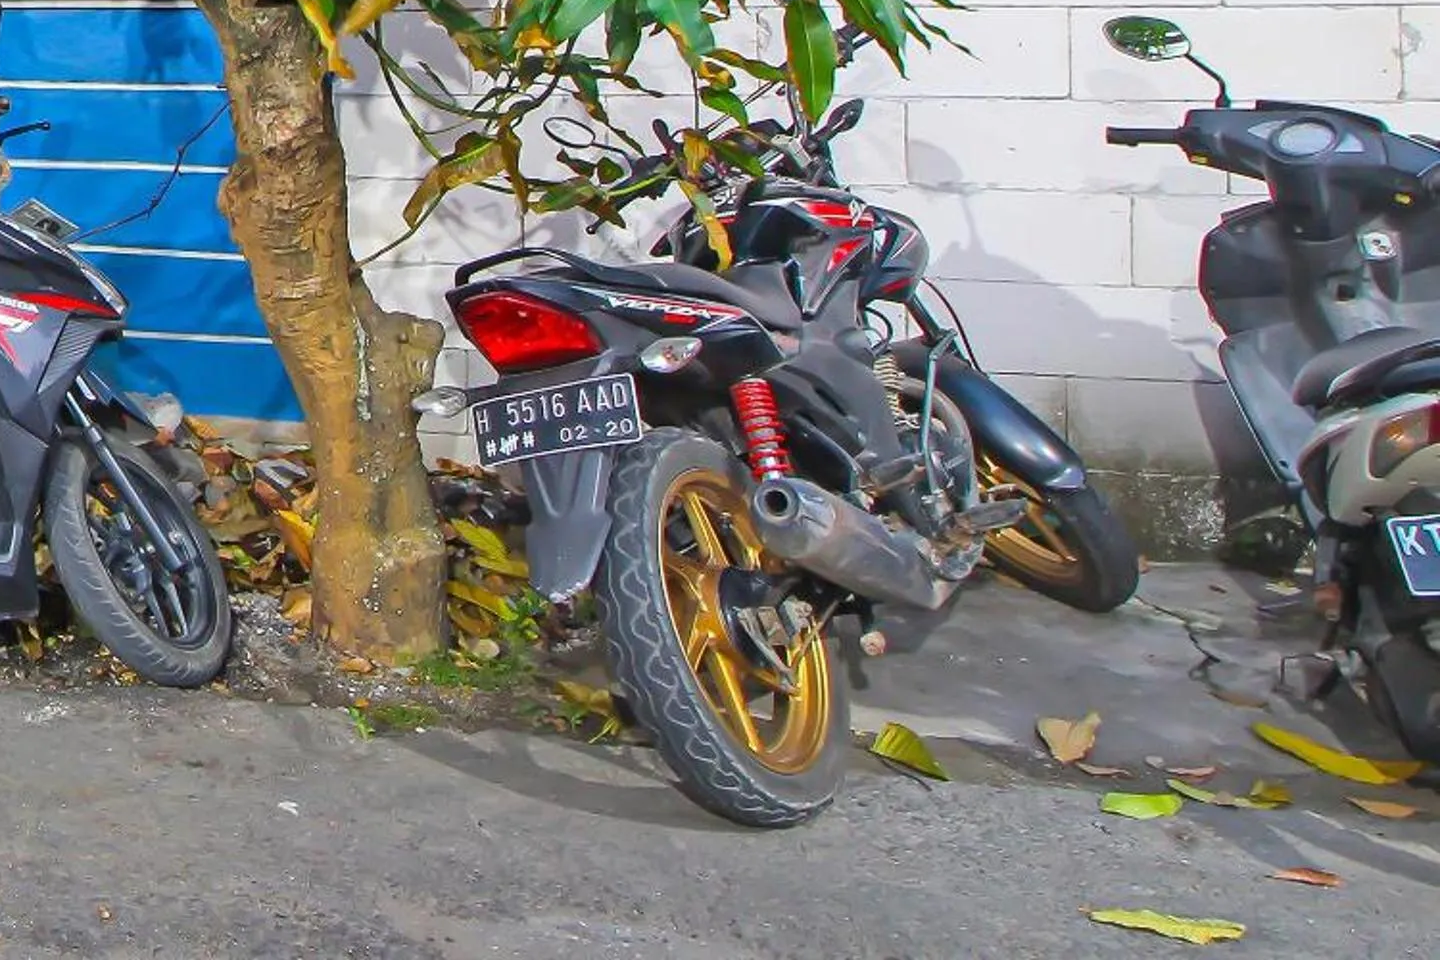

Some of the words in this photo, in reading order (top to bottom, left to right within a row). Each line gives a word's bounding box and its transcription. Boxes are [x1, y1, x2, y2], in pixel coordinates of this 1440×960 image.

[476, 409, 491, 435] H
[506, 393, 566, 426] 5516
[577, 382, 628, 414] AAD
